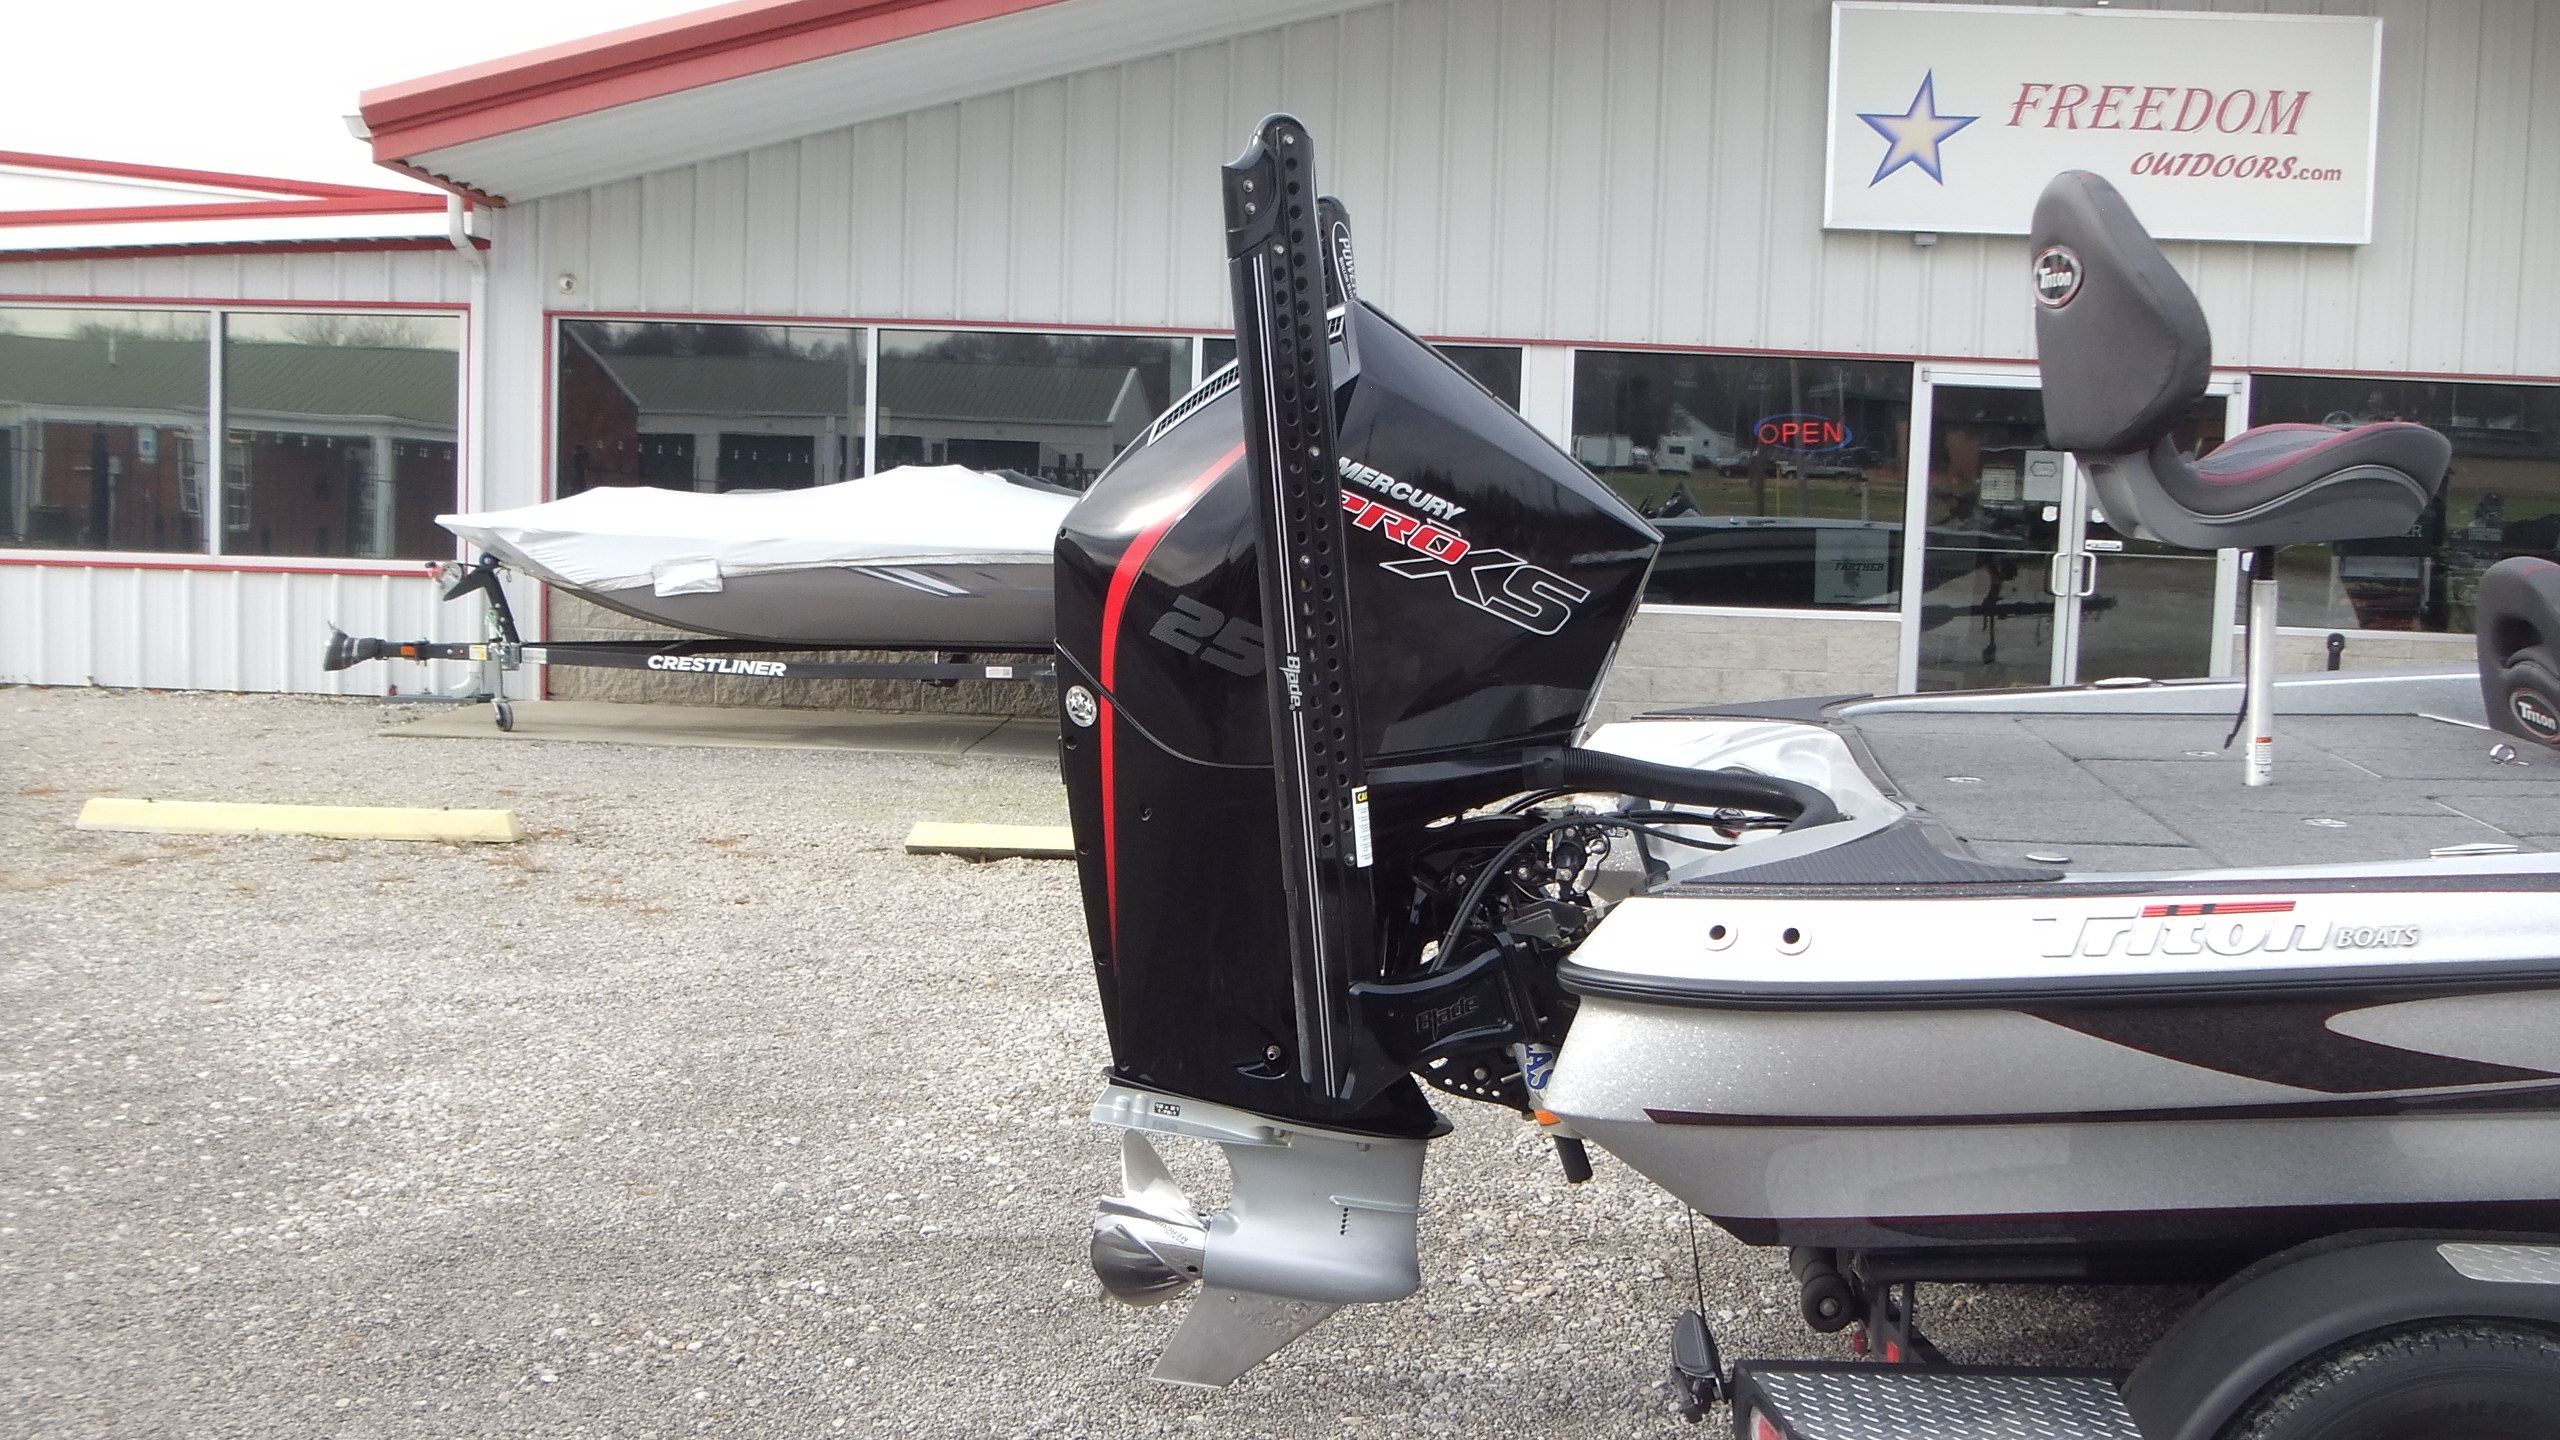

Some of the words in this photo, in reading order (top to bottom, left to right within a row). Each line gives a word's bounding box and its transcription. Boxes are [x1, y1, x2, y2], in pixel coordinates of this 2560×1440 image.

[2006, 82, 2312, 137] FREEDOM
[2130, 151, 2342, 182] OUTDOORS.com
[1758, 421, 1844, 445] OPEN
[1338, 456, 1467, 521] MERCURY
[1378, 548, 1591, 636] XS
[1150, 594, 1266, 677] 25
[647, 654, 787, 677] CRESTLINER
[1279, 655, 1302, 708] Blade
[2032, 901, 2334, 958] Triton
[2336, 926, 2419, 949] BOATS
[1417, 996, 1480, 1041] Blade
